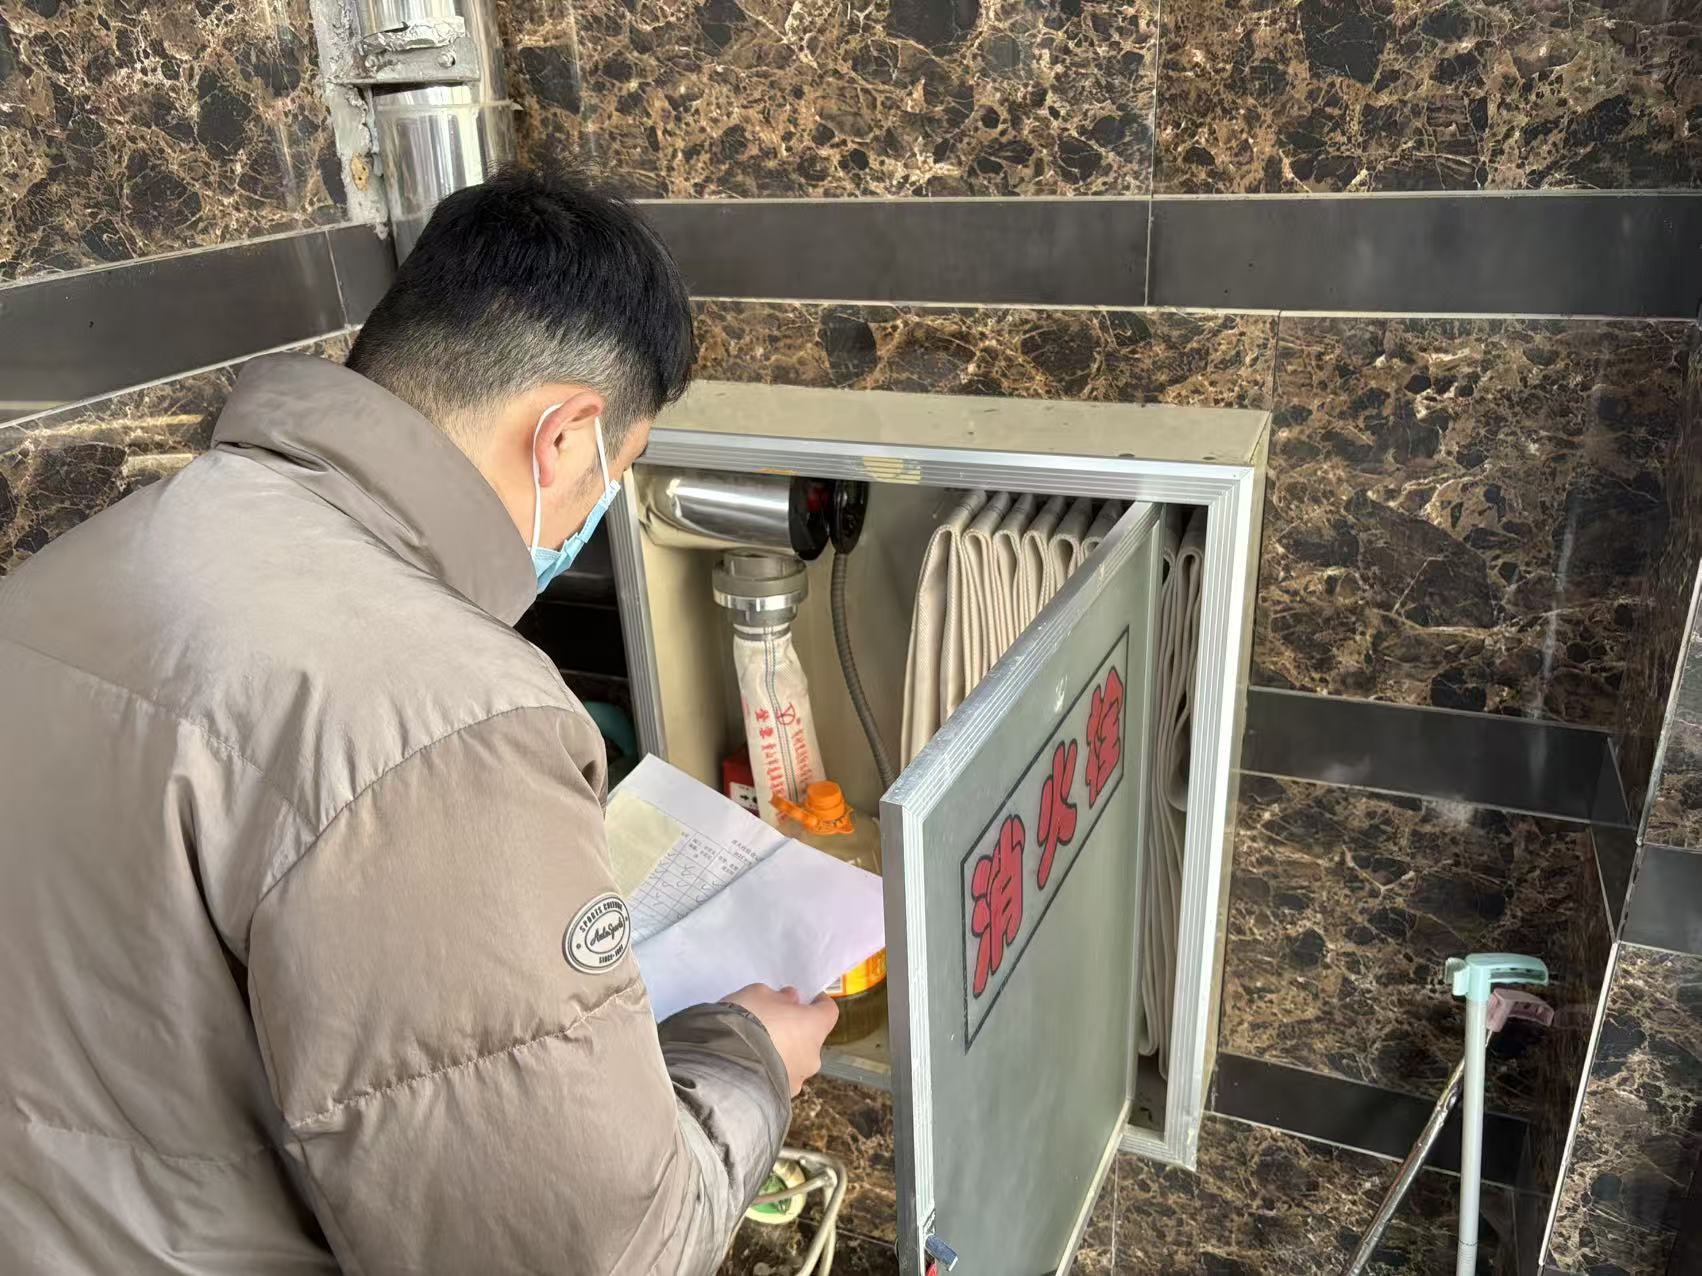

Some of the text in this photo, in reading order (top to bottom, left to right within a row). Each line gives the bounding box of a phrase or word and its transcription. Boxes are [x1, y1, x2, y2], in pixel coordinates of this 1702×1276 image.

[580, 906, 602, 933] SPORTS
[971, 666, 1124, 998] 消火栓
